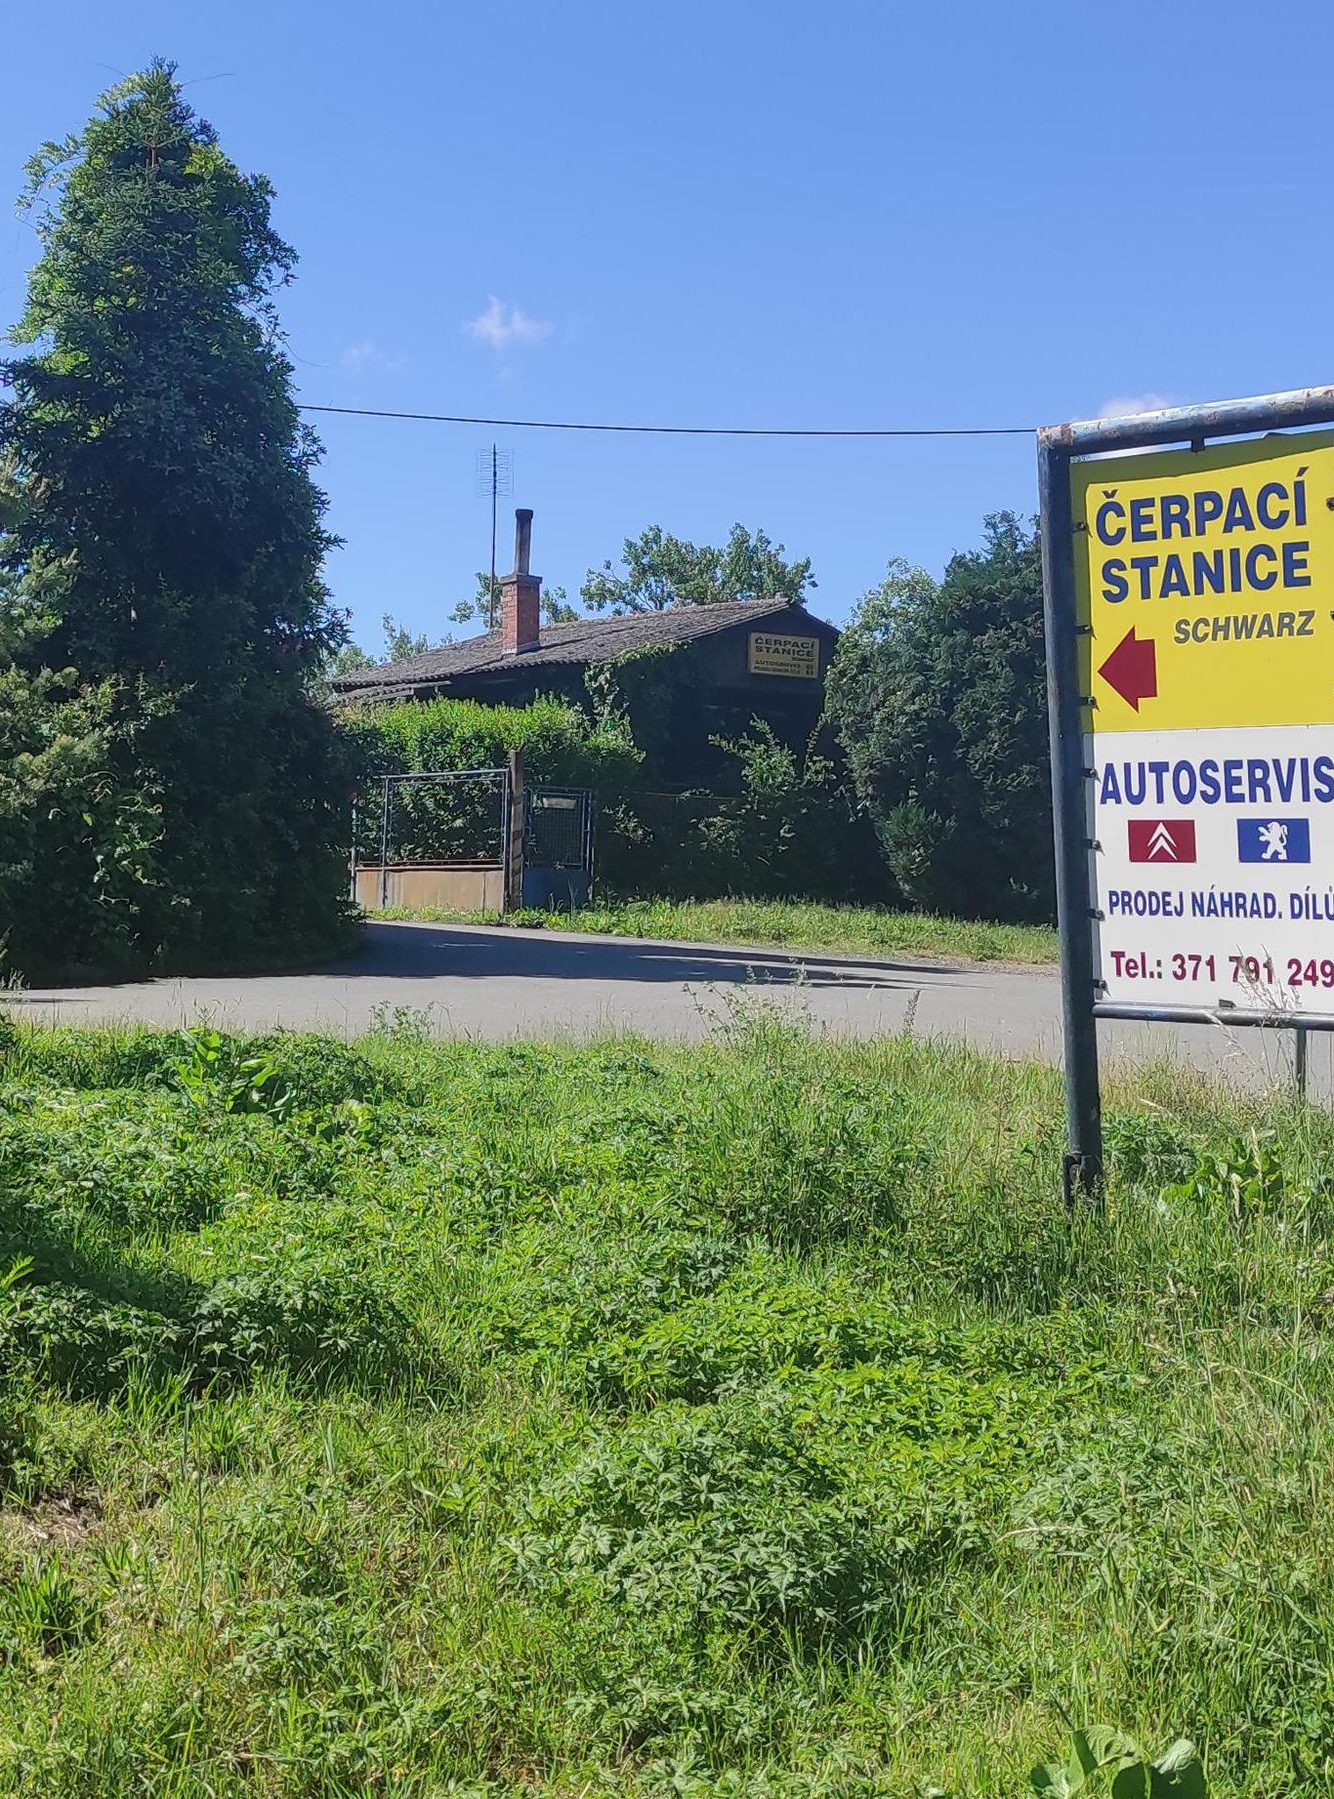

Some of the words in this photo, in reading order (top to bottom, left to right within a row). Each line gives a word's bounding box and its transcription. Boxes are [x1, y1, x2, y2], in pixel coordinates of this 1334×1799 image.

[1096, 466, 1310, 546] ČERPACÍ
[1101, 541, 1311, 603] STANICE
[1174, 610, 1315, 644] SCHWARZ
[754, 645, 814, 657] STANICE
[1108, 890, 1184, 917] PRODEJ
[1191, 884, 1283, 919] NÁHRAD.
[1111, 951, 1163, 980] Tel.:
[1172, 953, 1216, 982] 371
[1229, 955, 1275, 985] 791
